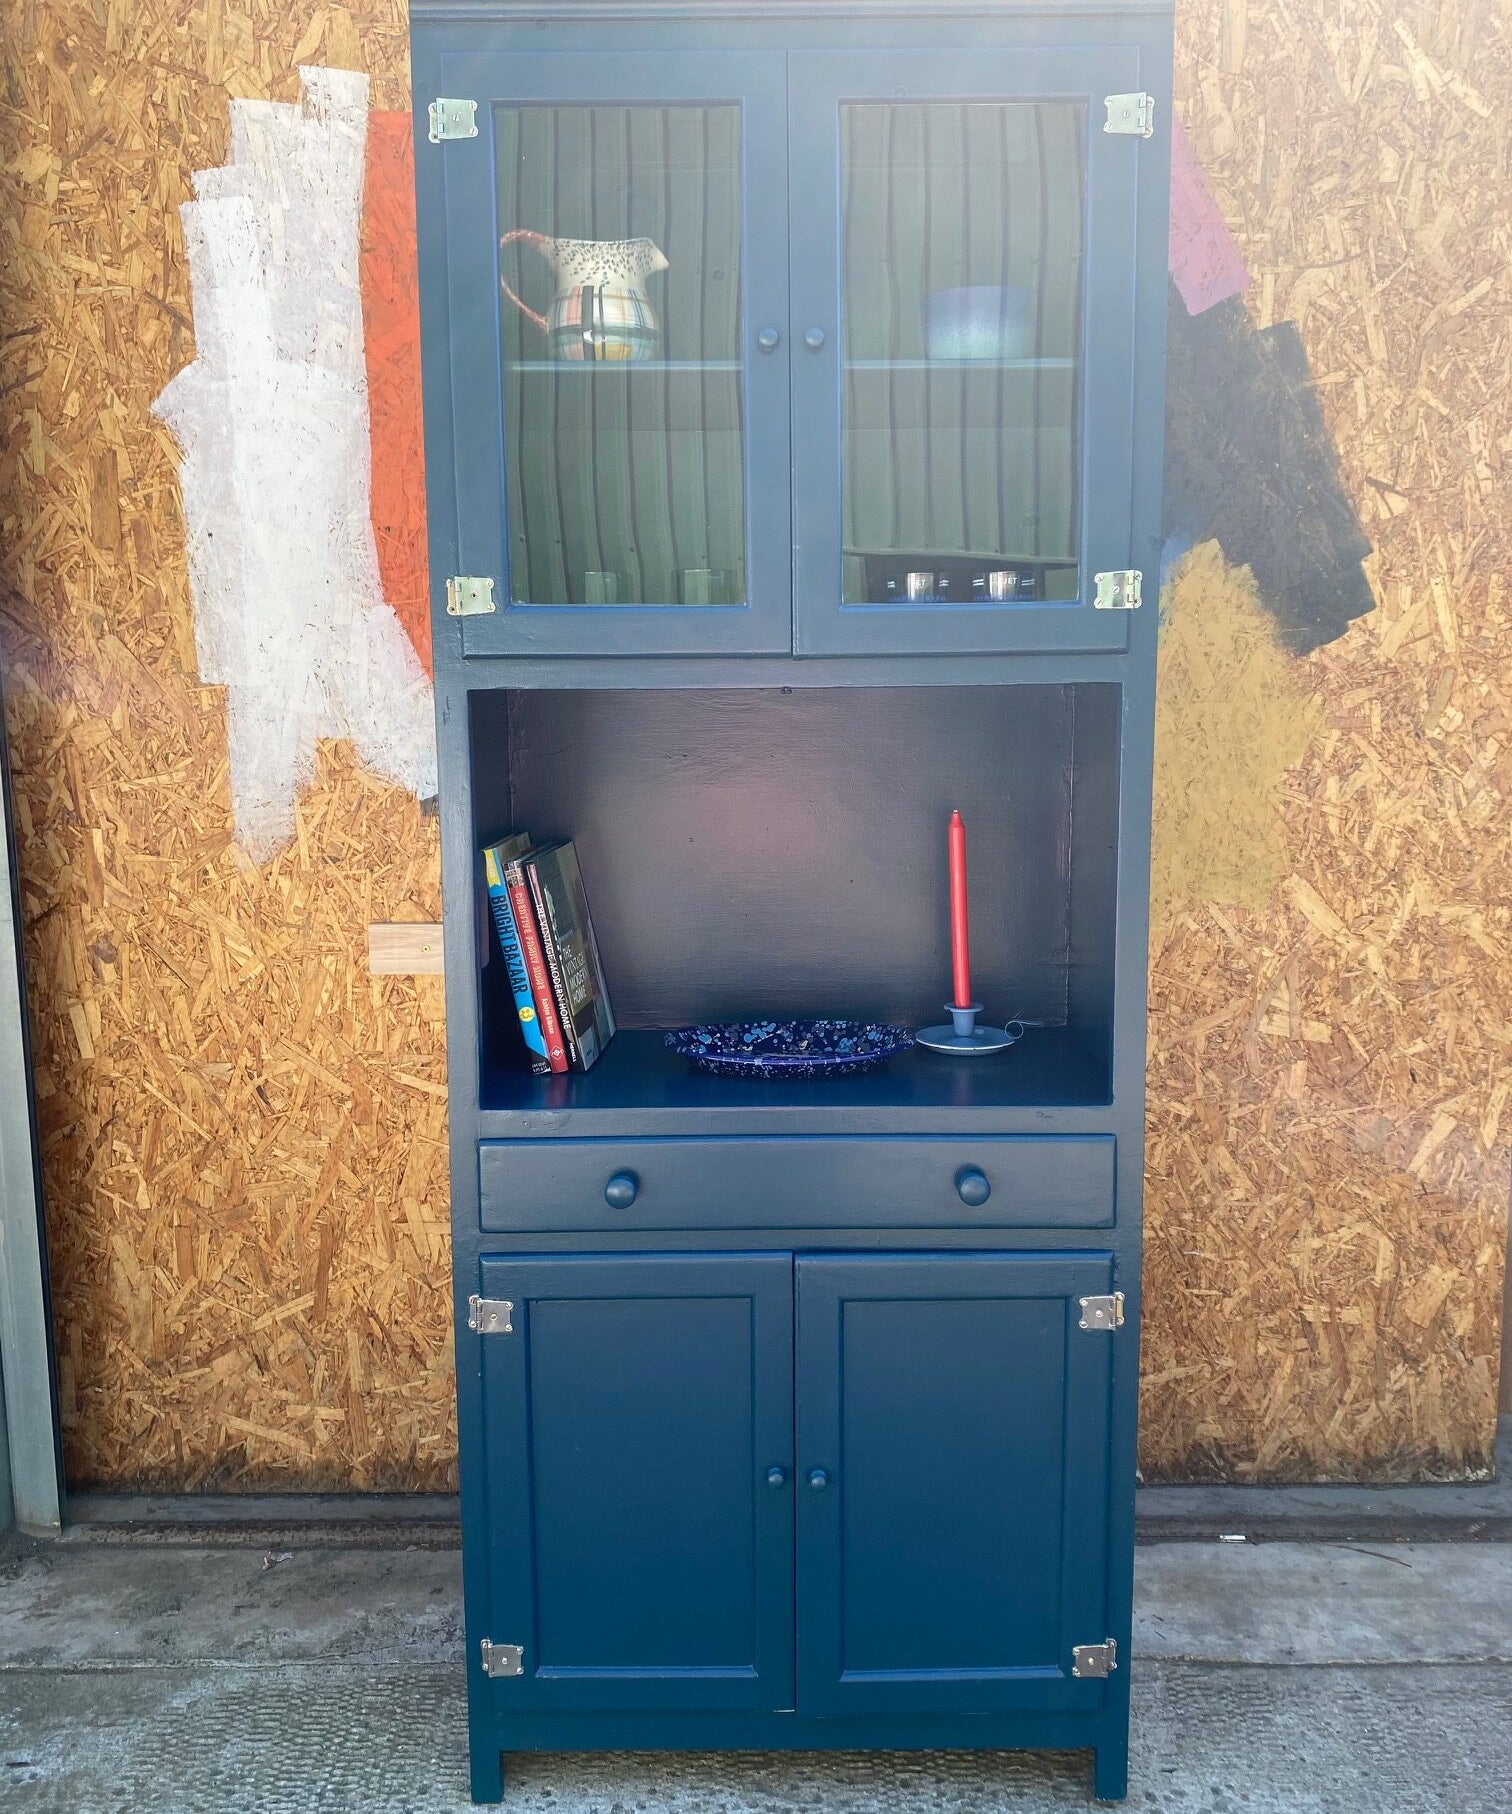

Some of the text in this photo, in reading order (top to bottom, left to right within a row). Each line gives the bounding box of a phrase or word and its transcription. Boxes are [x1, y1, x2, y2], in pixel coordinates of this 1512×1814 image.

[491, 894, 517, 941] BRIGHT
[502, 944, 529, 994] BAZAAR
[536, 903, 572, 1031] THE VINTAGE MODERN HOME
